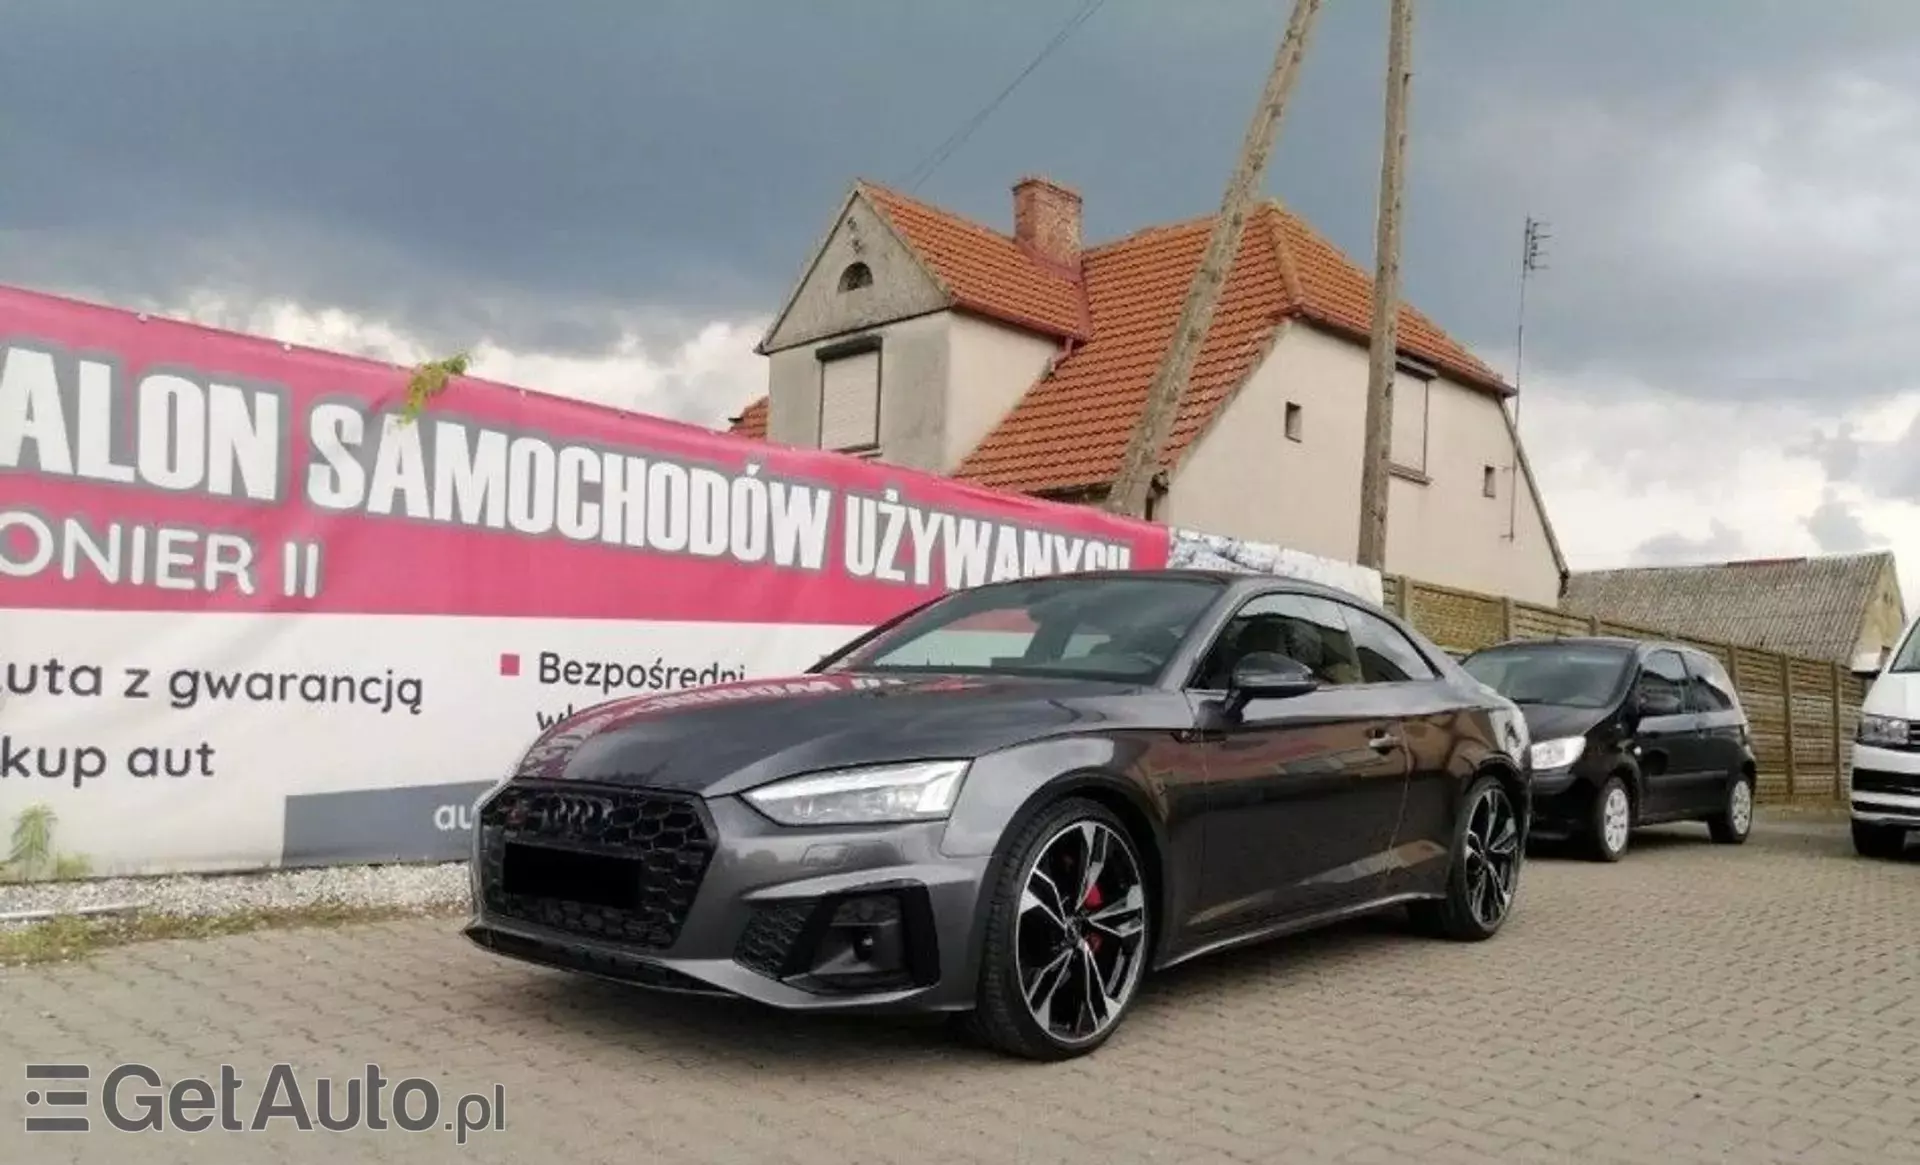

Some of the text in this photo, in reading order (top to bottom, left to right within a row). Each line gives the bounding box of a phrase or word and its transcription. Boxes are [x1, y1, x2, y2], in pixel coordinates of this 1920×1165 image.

[0, 346, 279, 500] ALON
[307, 403, 831, 570] SAMOCHODÓW
[0, 511, 254, 595] ONIER
[0, 658, 424, 714] uta z gwarancją
[127, 740, 215, 778] aut
